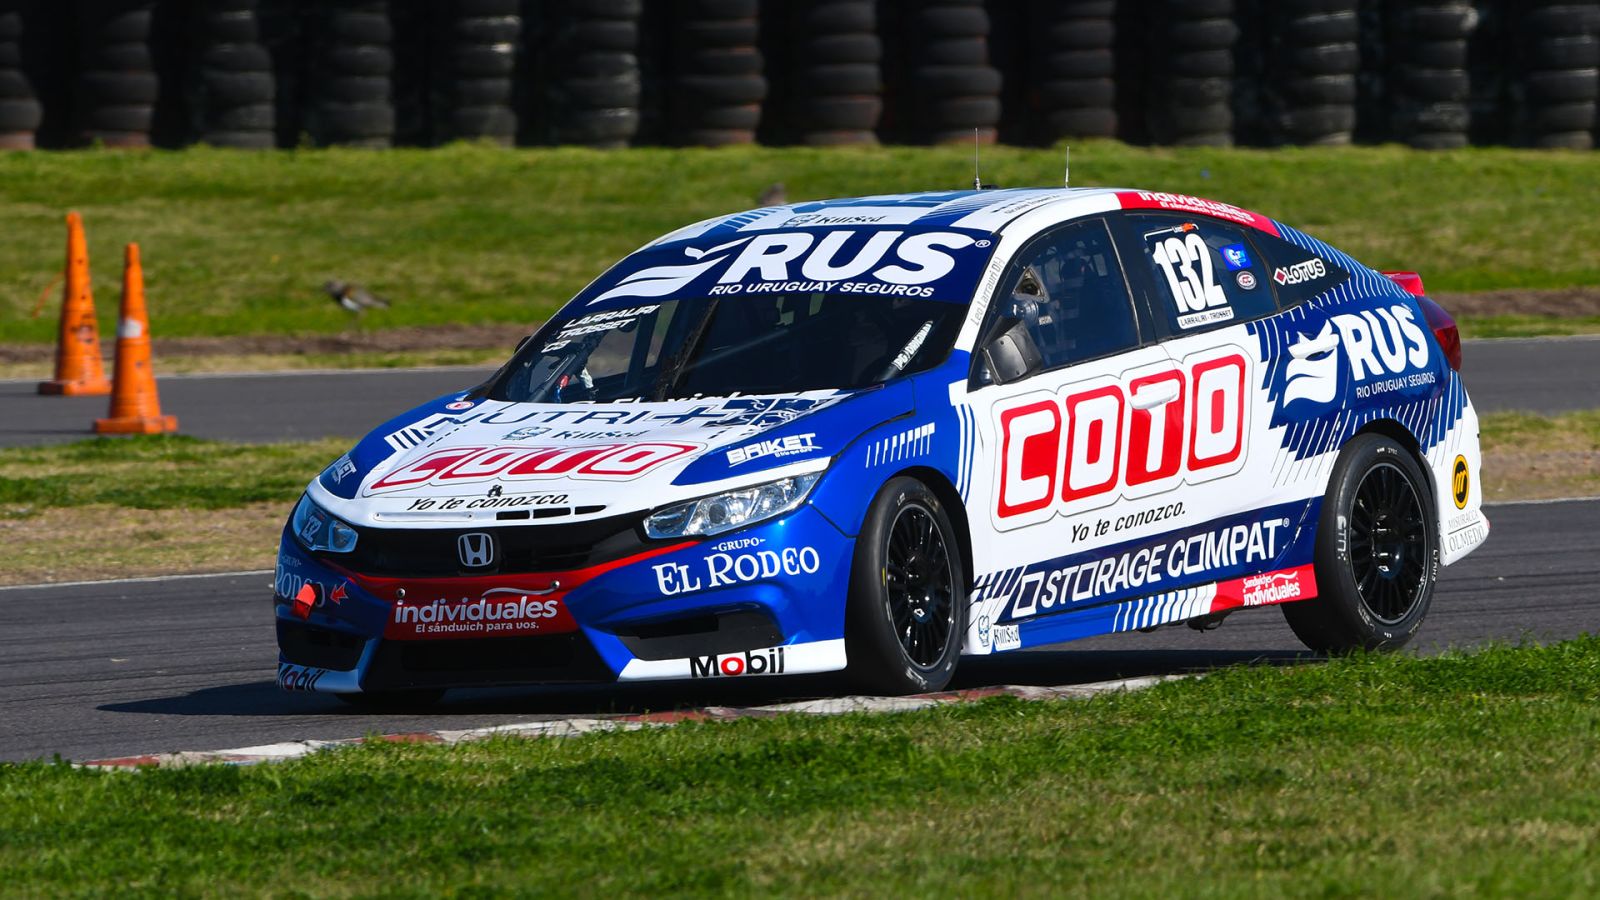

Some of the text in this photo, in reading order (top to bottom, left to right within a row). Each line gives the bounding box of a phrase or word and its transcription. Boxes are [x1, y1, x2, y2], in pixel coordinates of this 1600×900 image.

[1152, 233, 1228, 314] 132
[1286, 259, 1326, 284] LOTUS
[708, 281, 935, 298] RIO URUGUAY SEGUROS
[970, 302, 984, 327] Leo
[979, 269, 998, 309] Larrauri
[556, 318, 636, 340] TROSSET
[563, 304, 660, 329] LARRAURI
[1330, 304, 1429, 382] RUS
[1356, 372, 1436, 399] RIO URUGUAY SEGUROS
[726, 432, 816, 465] BRIKET
[997, 353, 1246, 519] COTO
[370, 443, 698, 490] COTO
[407, 494, 569, 511] Yo te conozco.
[1071, 502, 1186, 544] Yo te conozco.
[718, 537, 760, 552] GRUPO
[652, 546, 820, 596] EL RODEO
[1041, 545, 1163, 608] STORAGE
[1167, 518, 1283, 576] COMPAT
[1243, 579, 1301, 607] individuales
[395, 595, 558, 624] individuales
[415, 621, 539, 633] El sándwich para vos.
[689, 647, 784, 678] Mobil
